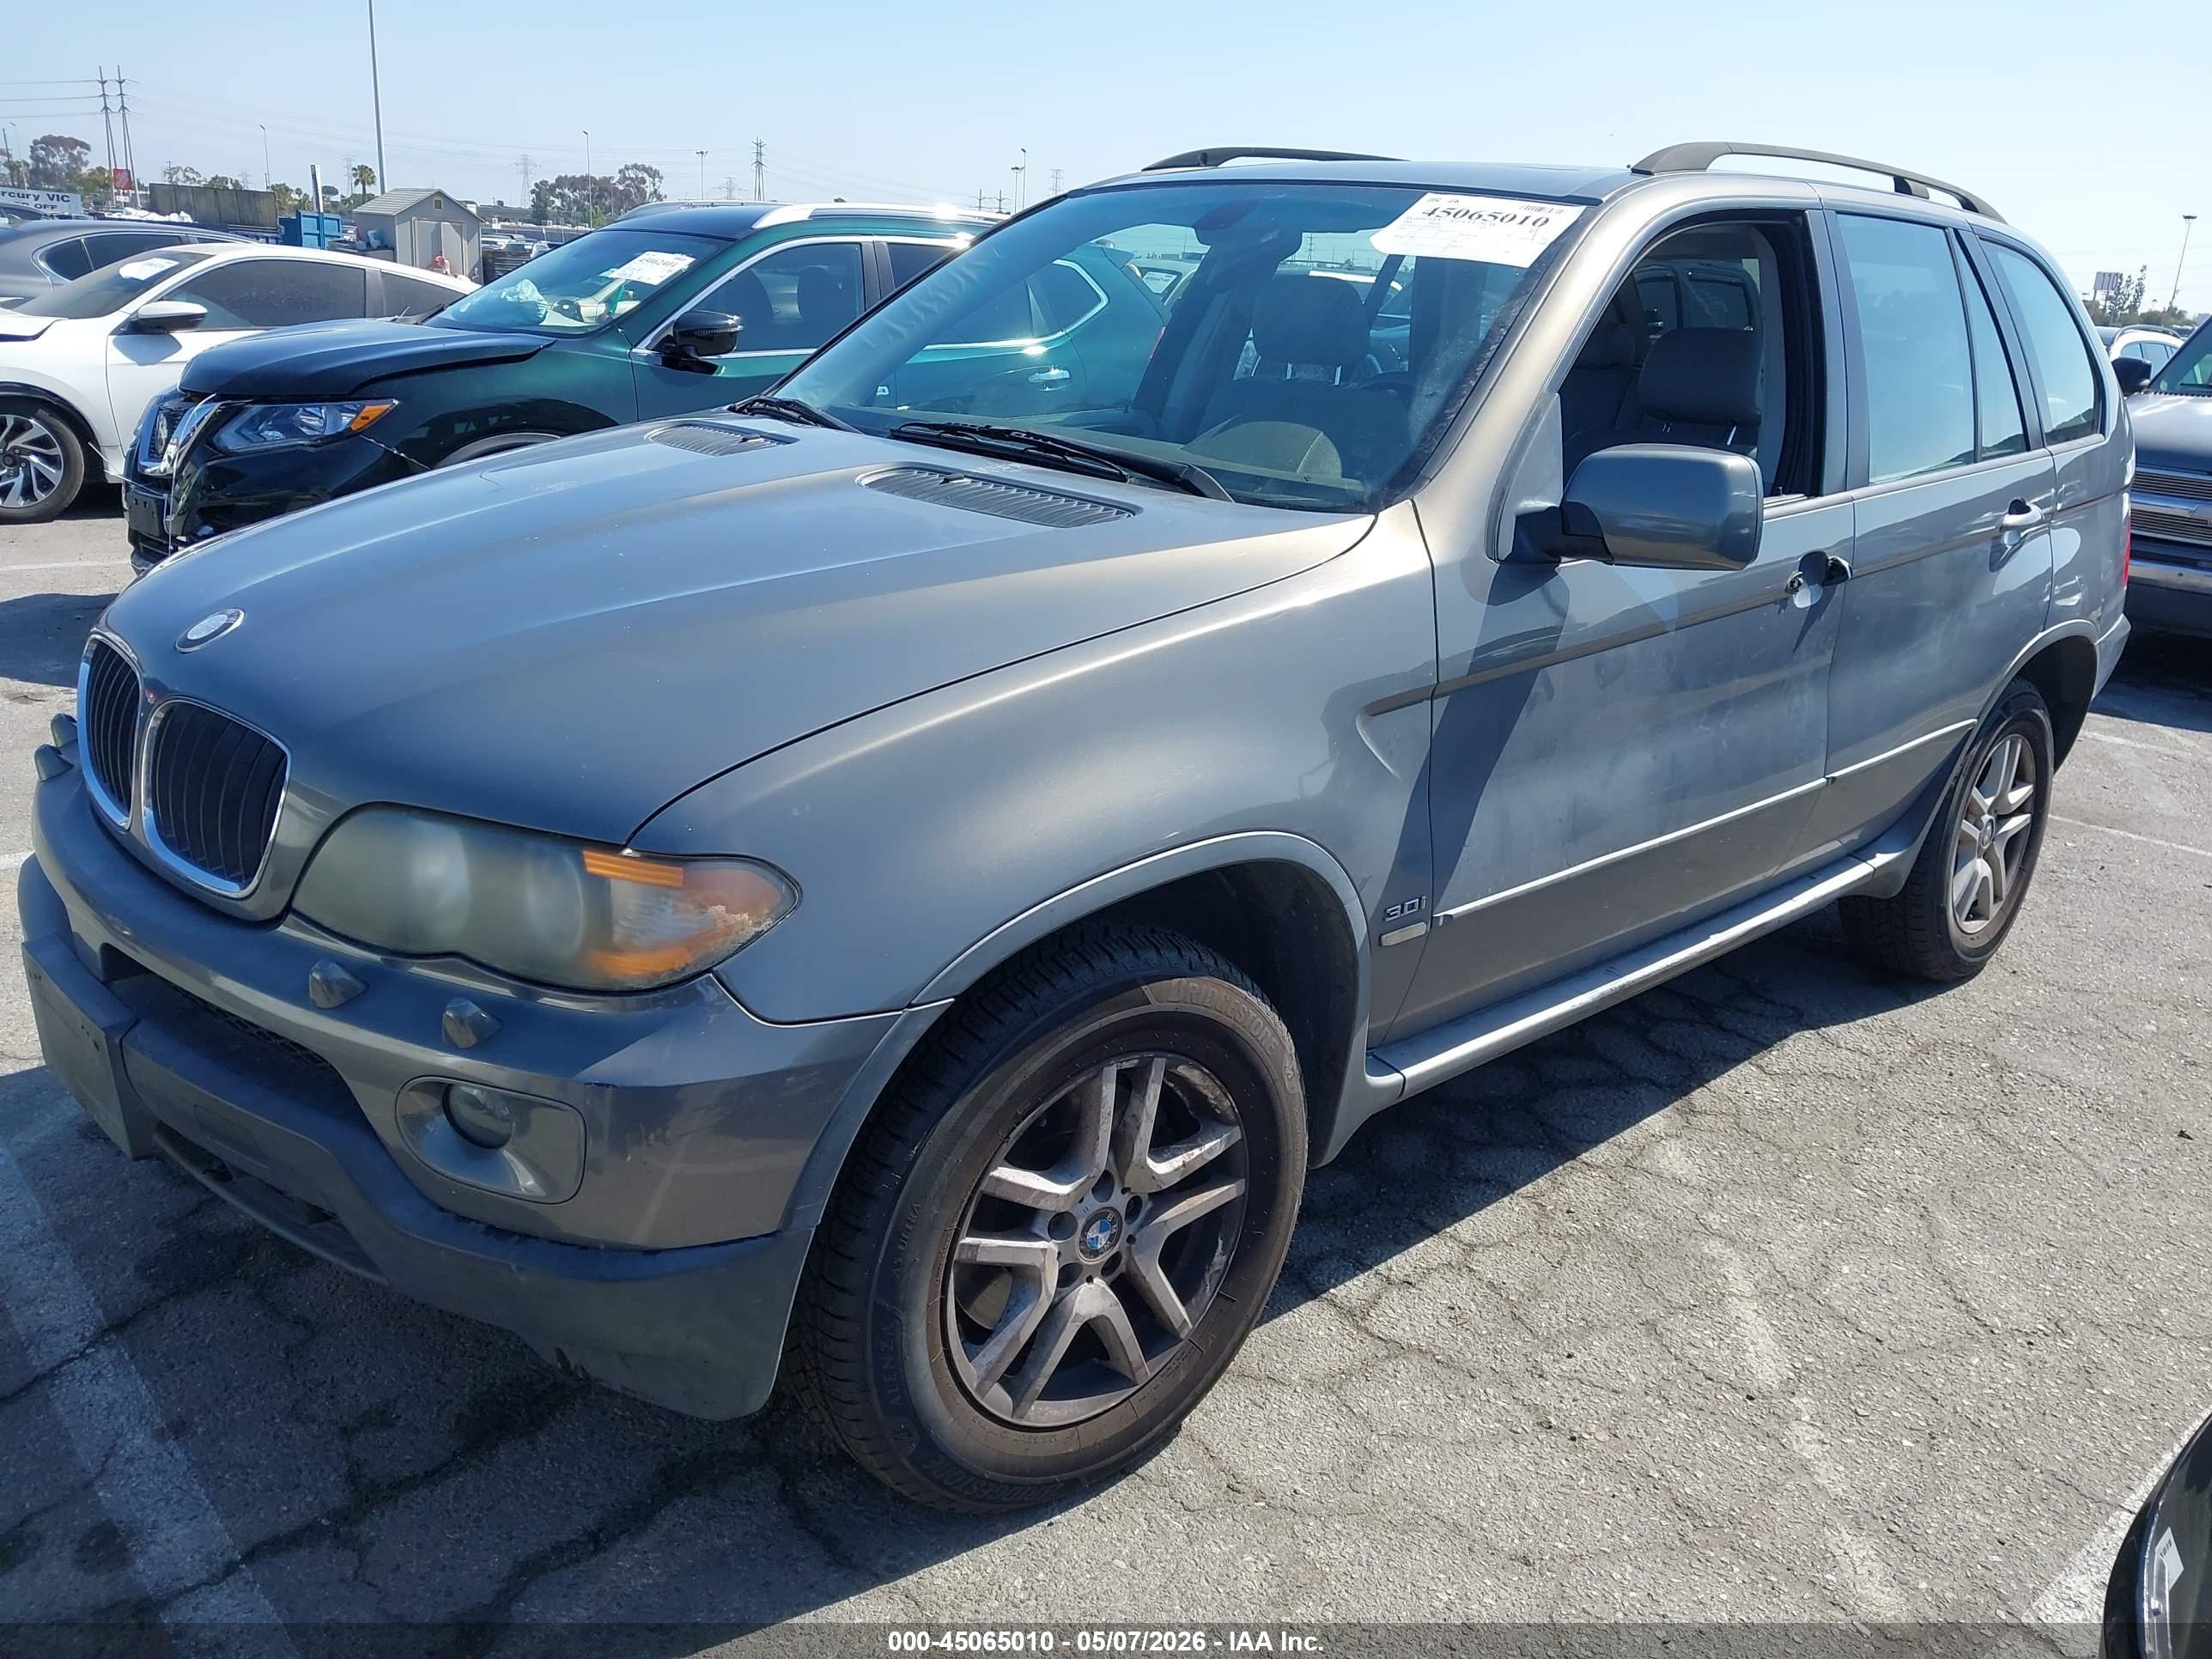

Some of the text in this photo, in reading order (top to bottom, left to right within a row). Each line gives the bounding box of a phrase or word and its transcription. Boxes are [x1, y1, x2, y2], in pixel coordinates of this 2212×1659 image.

[0, 191, 71, 203] rcury VIC
[1422, 206, 1550, 228] 45065010
[1385, 896, 1427, 922] 3.0i
